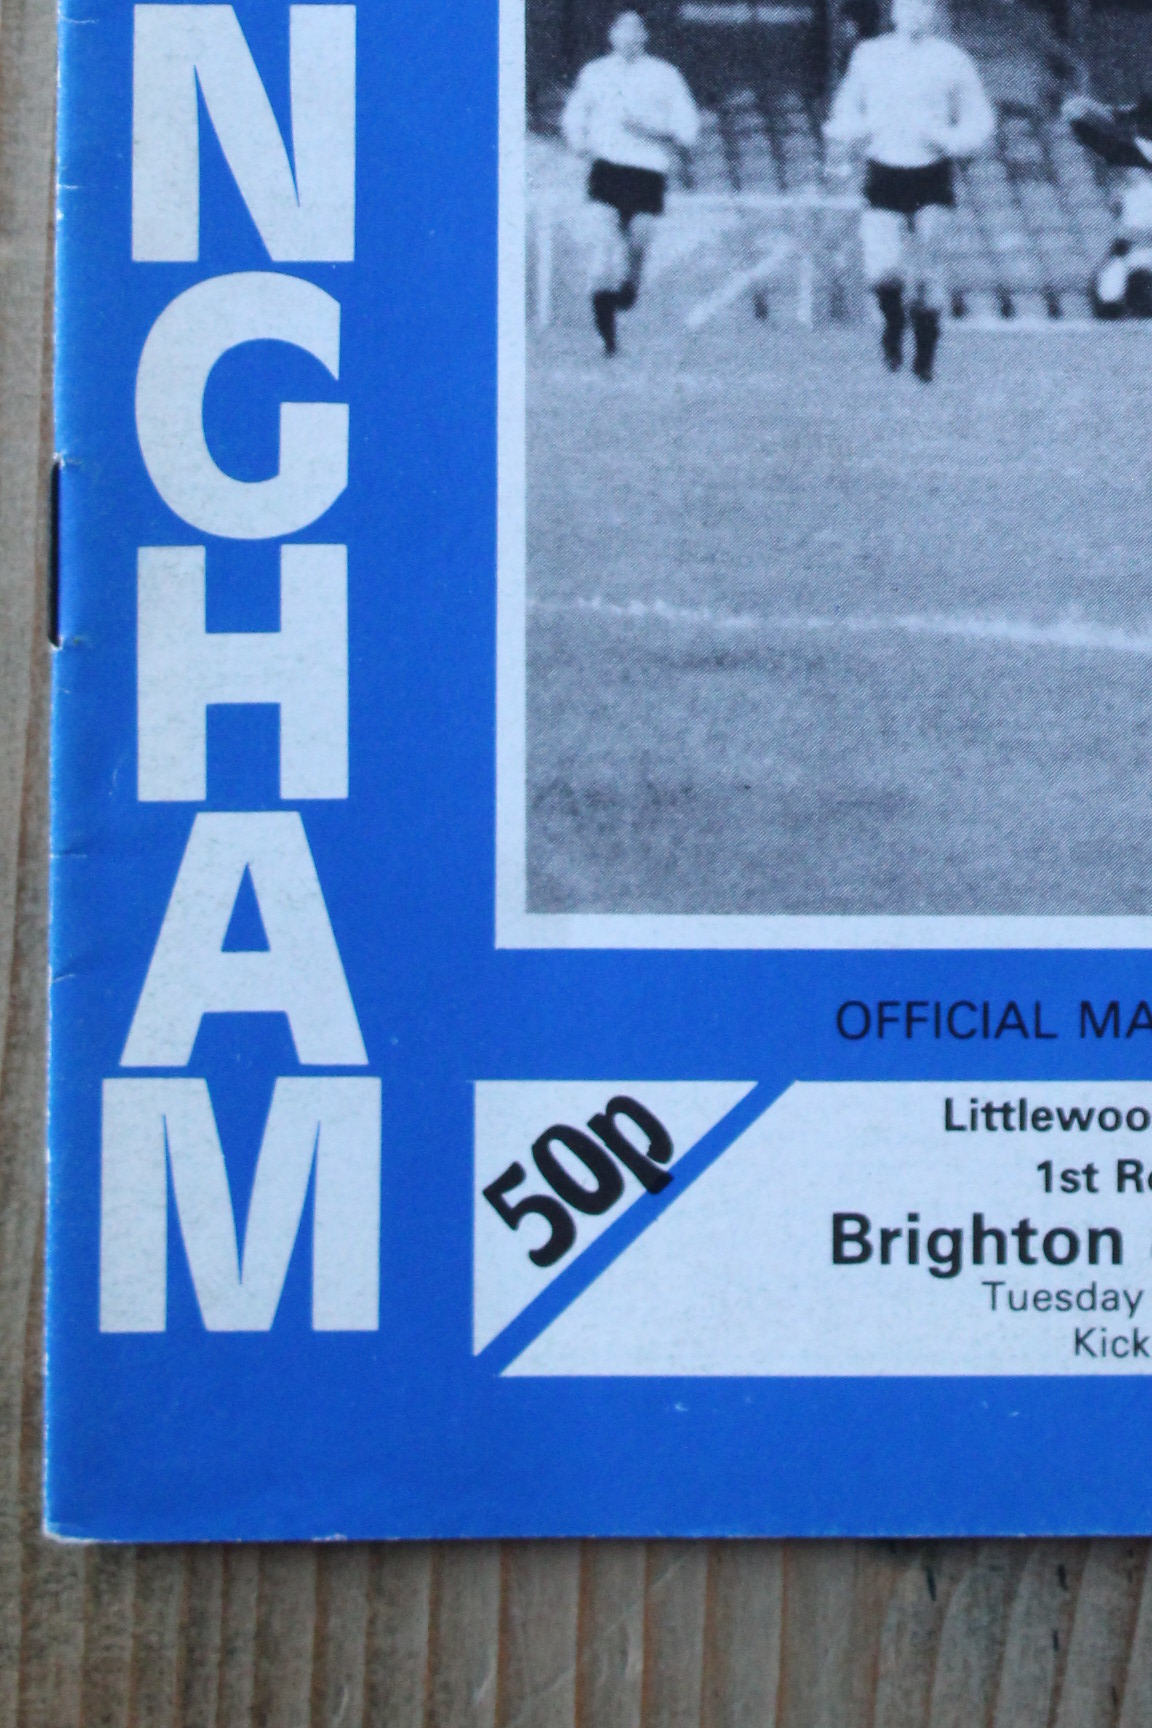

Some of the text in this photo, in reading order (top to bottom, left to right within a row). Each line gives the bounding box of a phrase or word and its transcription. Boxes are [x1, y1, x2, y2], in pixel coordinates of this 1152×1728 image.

[837, 1001, 1056, 1040] OFFICIAL
[481, 1094, 675, 1269] 50p
[1037, 1160, 1099, 1194] 1st
[832, 1212, 1123, 1279] Brighton
[982, 1281, 1143, 1318] Tuesday
